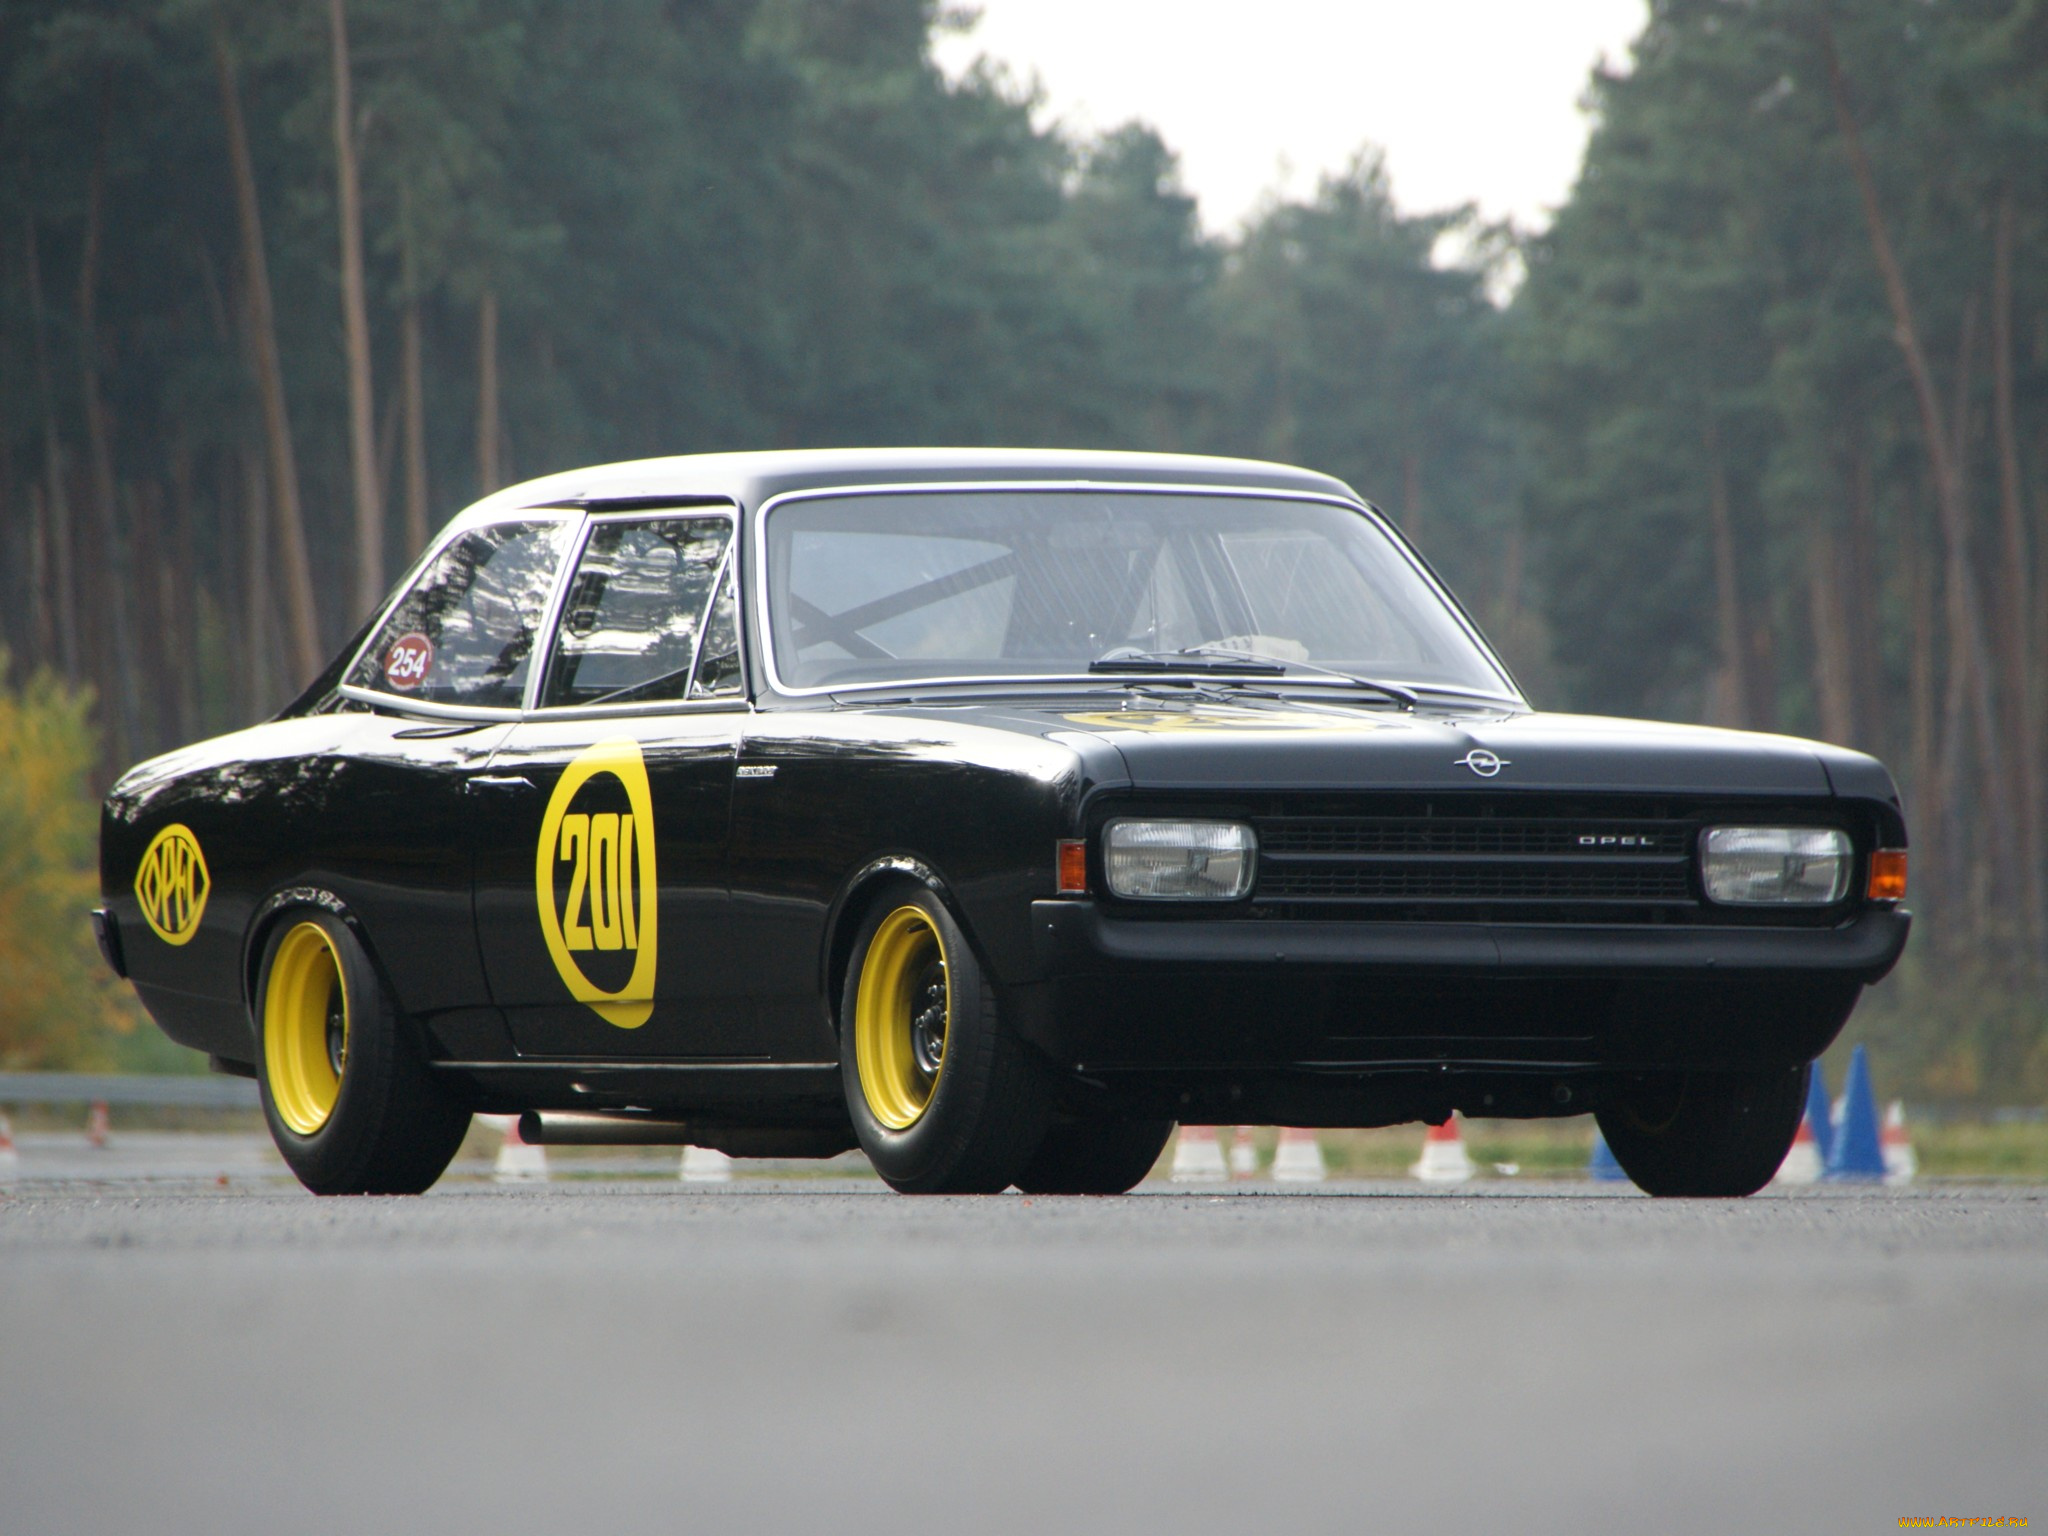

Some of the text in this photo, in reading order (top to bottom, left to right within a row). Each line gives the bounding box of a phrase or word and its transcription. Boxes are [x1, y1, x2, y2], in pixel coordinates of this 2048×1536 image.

[388, 646, 427, 679] 254
[1579, 836, 1655, 845] OPEL
[143, 836, 203, 934] OPEL
[560, 812, 638, 951] 201
